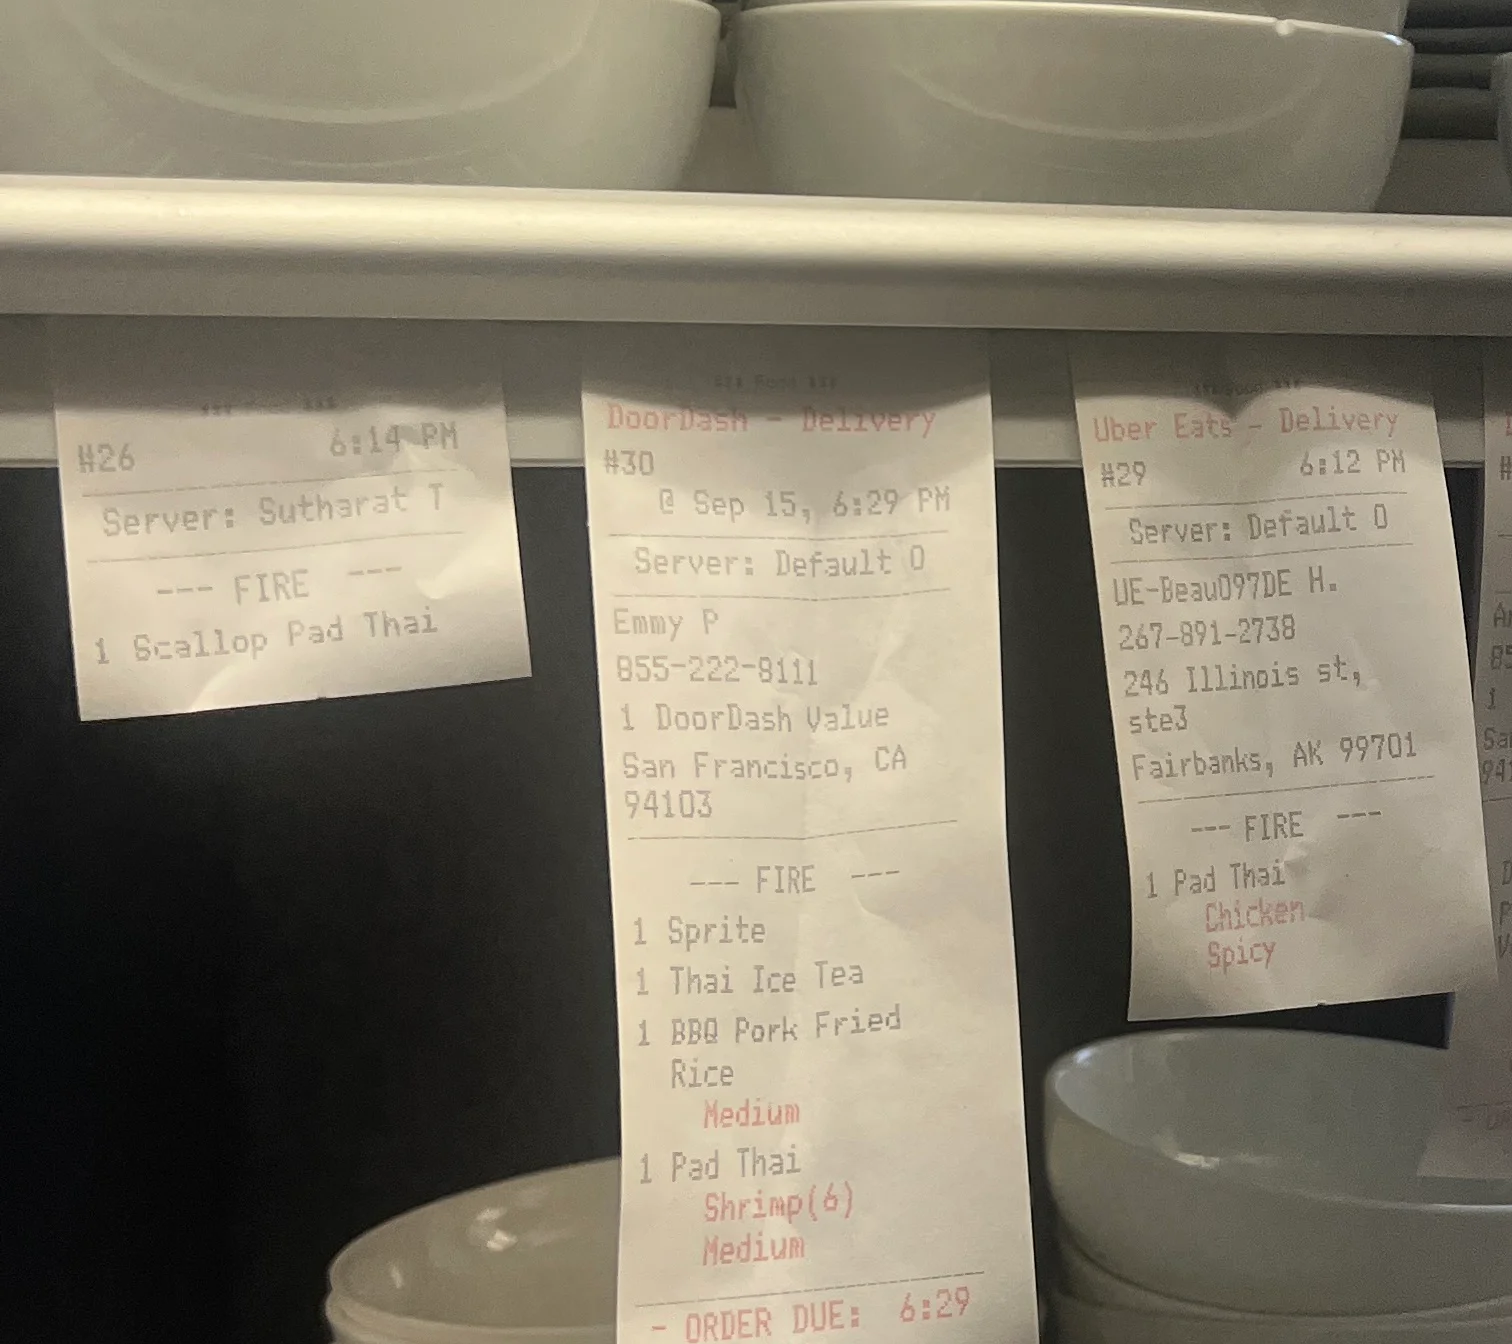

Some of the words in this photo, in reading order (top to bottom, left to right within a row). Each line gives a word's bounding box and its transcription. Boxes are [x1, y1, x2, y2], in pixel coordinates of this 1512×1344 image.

[607, 405, 748, 433] DoorDash
[802, 407, 936, 439] Delivery
[1094, 416, 1158, 442] Uber
[1174, 412, 1231, 439] Eats
[1279, 406, 1399, 438] Delivery
[77, 444, 136, 473] #26
[330, 425, 401, 456] 6:14
[421, 422, 458, 450] PM
[1300, 449, 1361, 475] 6:12
[1377, 448, 1406, 473] PM
[103, 507, 235, 537] Server:
[259, 487, 407, 526] Sutharat
[694, 490, 745, 522] Sep
[765, 491, 811, 524] 15,
[833, 490, 898, 518] 6:29
[918, 486, 950, 512] PM
[1130, 515, 1231, 544] Server:
[1247, 506, 1356, 540] Default
[635, 547, 755, 575] Server:
[776, 549, 891, 577] Default
[1308, 565, 1337, 593] H.
[233, 569, 310, 605] FIRE
[134, 629, 268, 661] Scallop
[288, 616, 345, 644] Pad
[363, 607, 438, 637] Thai
[614, 608, 683, 641] Emmy
[1119, 613, 1296, 651] 267-891-2738
[616, 655, 818, 685] 855-222-8111
[1124, 668, 1169, 697] 246
[1186, 663, 1300, 693] Illinois
[1318, 655, 1360, 687] st,
[656, 703, 792, 733] DoorDash
[807, 704, 889, 733] Value
[1129, 705, 1189, 733] ste3
[623, 751, 675, 779] San
[695, 751, 853, 782] Francisco,
[875, 745, 907, 772] CA
[1133, 746, 1274, 781] Fairbanks,
[1293, 739, 1324, 769] AK
[1339, 731, 1417, 762] 99701
[625, 790, 713, 819] 94103
[1245, 810, 1304, 842] FIRE
[756, 865, 816, 894] FIRE
[1174, 865, 1216, 896] Pad
[1230, 860, 1286, 890] Thai
[1205, 896, 1305, 933] Chicken
[668, 915, 766, 951] Sprite
[1208, 939, 1276, 973] Spicy
[670, 966, 734, 995] Thai
[752, 964, 797, 993] Ice
[815, 960, 864, 989] Tea
[672, 1017, 718, 1046] BBQ
[736, 1017, 798, 1044] Pork
[815, 1004, 901, 1038] Fried
[672, 1059, 734, 1088] Rice
[704, 1098, 799, 1129] Medium
[672, 1151, 719, 1182] Pad
[737, 1144, 801, 1177] Thai
[705, 1181, 854, 1224] Shrimp(6)
[702, 1232, 806, 1266] Medium
[685, 1307, 772, 1344] ORDER
[792, 1300, 860, 1334] DUE:
[900, 1286, 970, 1323] 6:29
